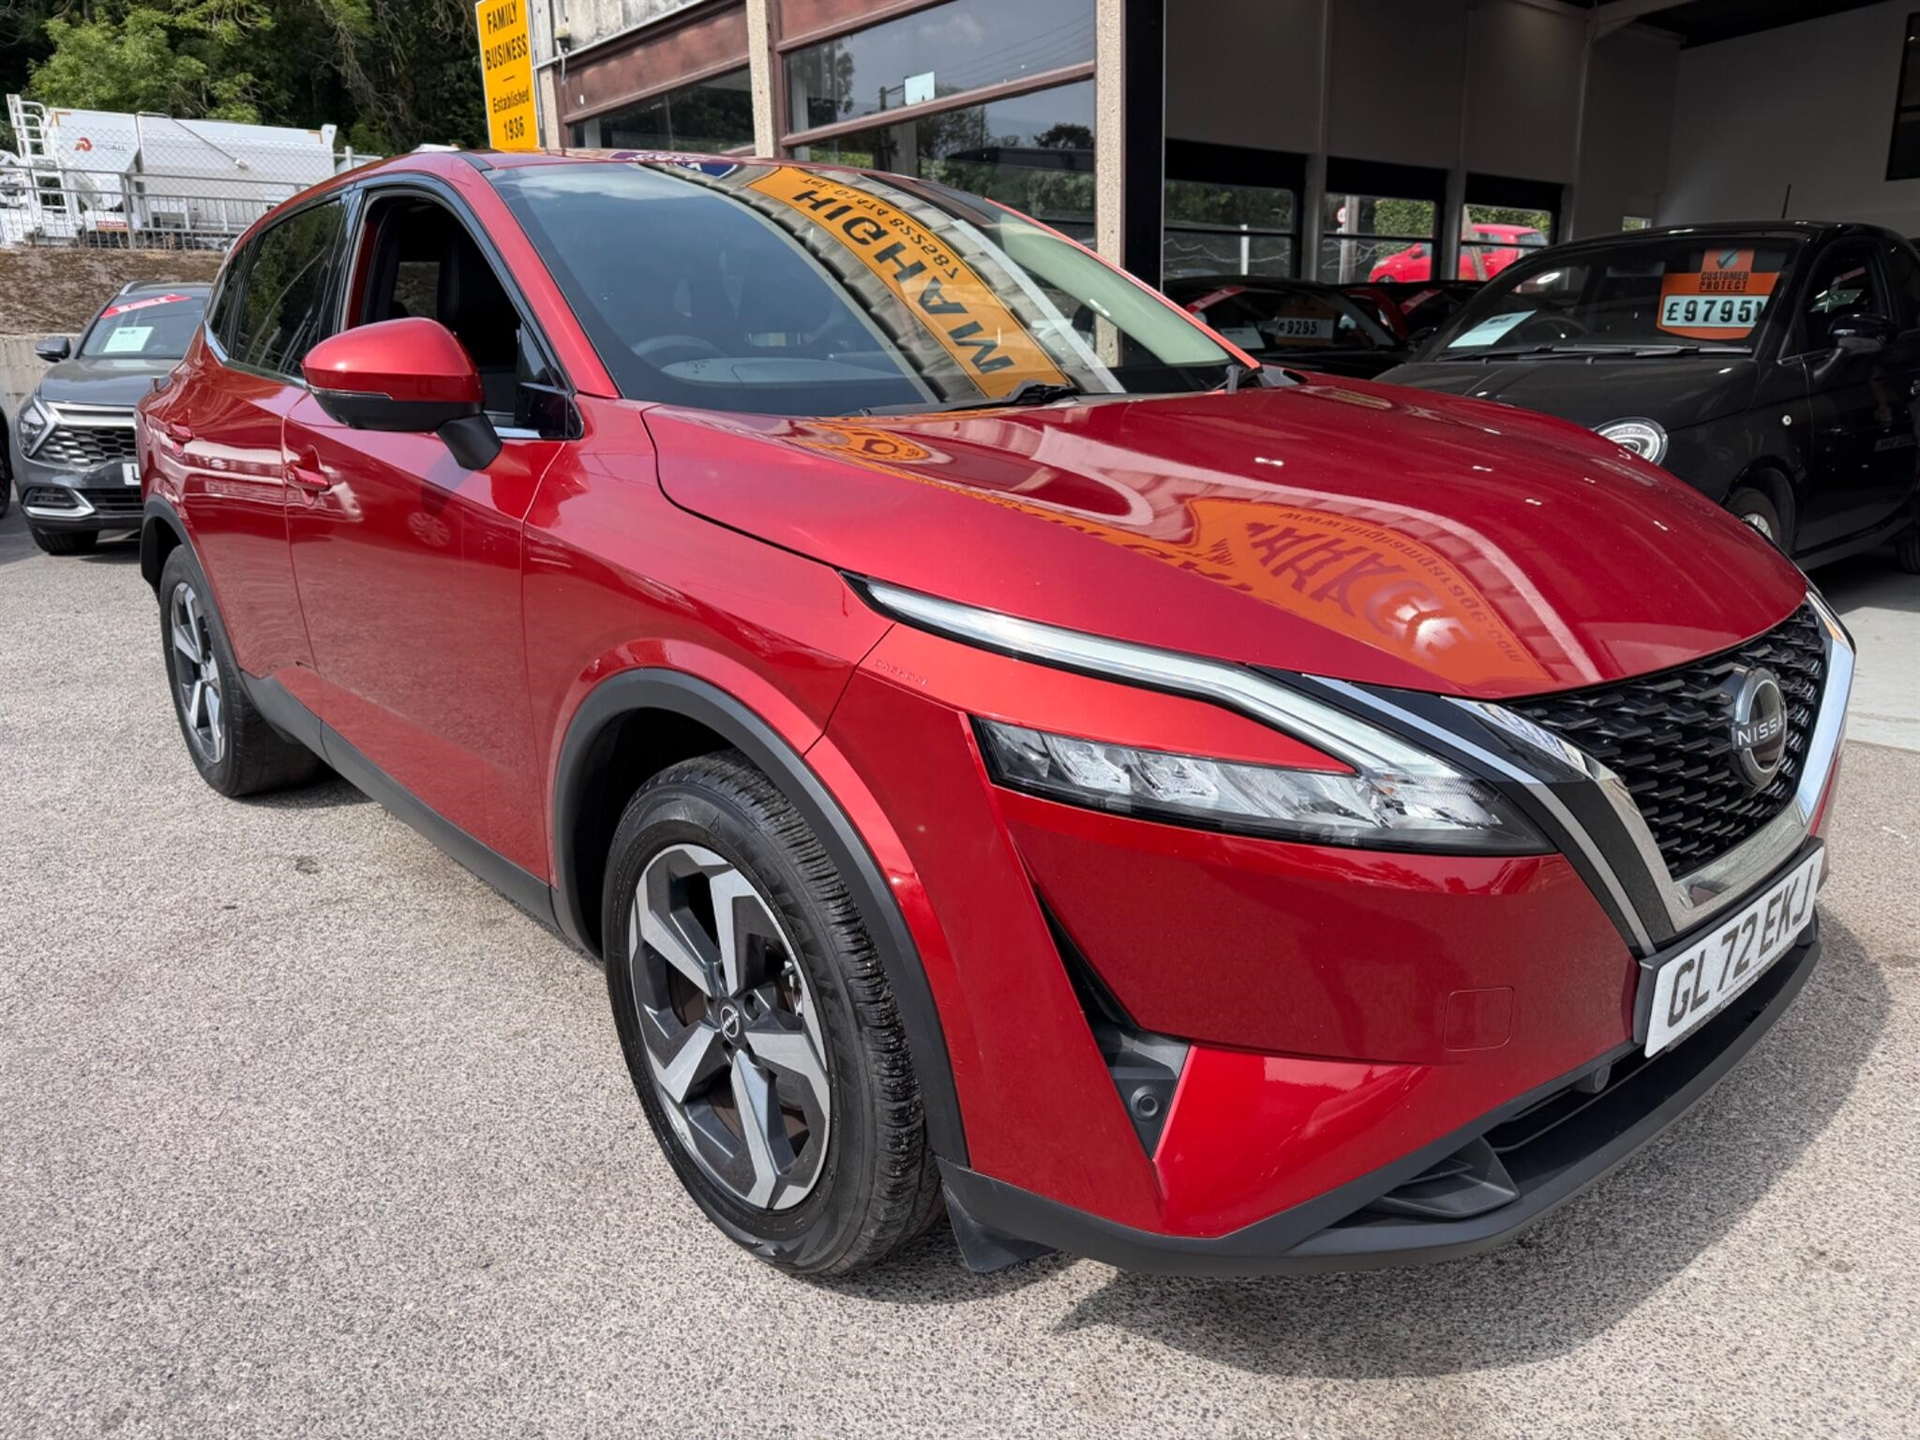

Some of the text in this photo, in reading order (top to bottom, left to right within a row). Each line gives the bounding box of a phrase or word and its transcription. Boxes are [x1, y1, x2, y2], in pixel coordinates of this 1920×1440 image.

[486, 1, 518, 35] FAMILY
[485, 33, 528, 71] BUSINESS
[492, 85, 530, 114] Established
[503, 116, 525, 142] 1936
[1699, 281, 1748, 290] PROTECT
[1700, 271, 1749, 280] CUSTOMER
[1758, 864, 1815, 959] EKJ
